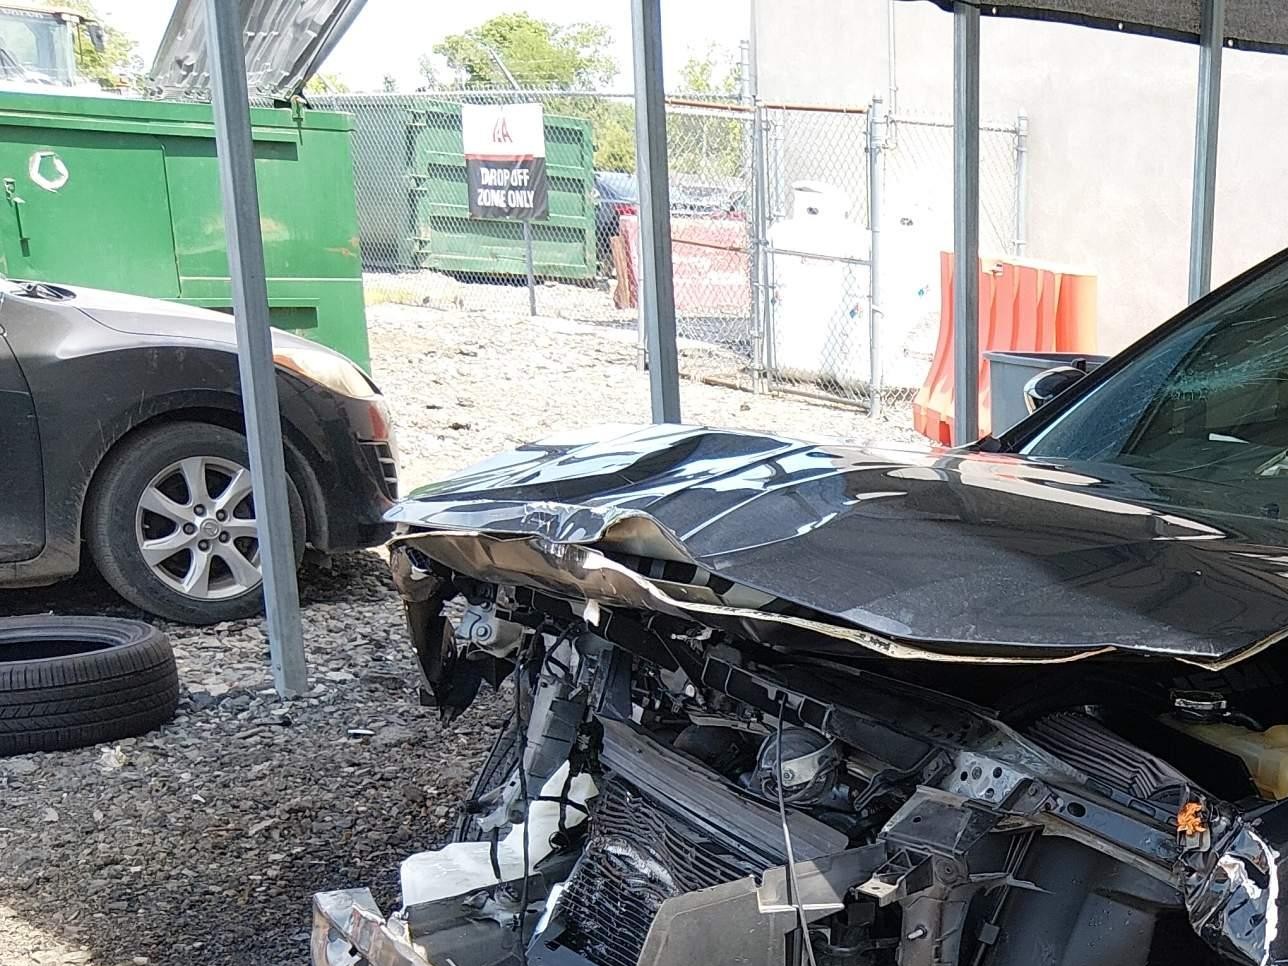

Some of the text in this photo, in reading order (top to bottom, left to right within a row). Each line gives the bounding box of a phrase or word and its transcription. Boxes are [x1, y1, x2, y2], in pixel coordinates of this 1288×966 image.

[480, 168, 530, 187] DROP OFF
[477, 190, 535, 208] ZONE ONLY
